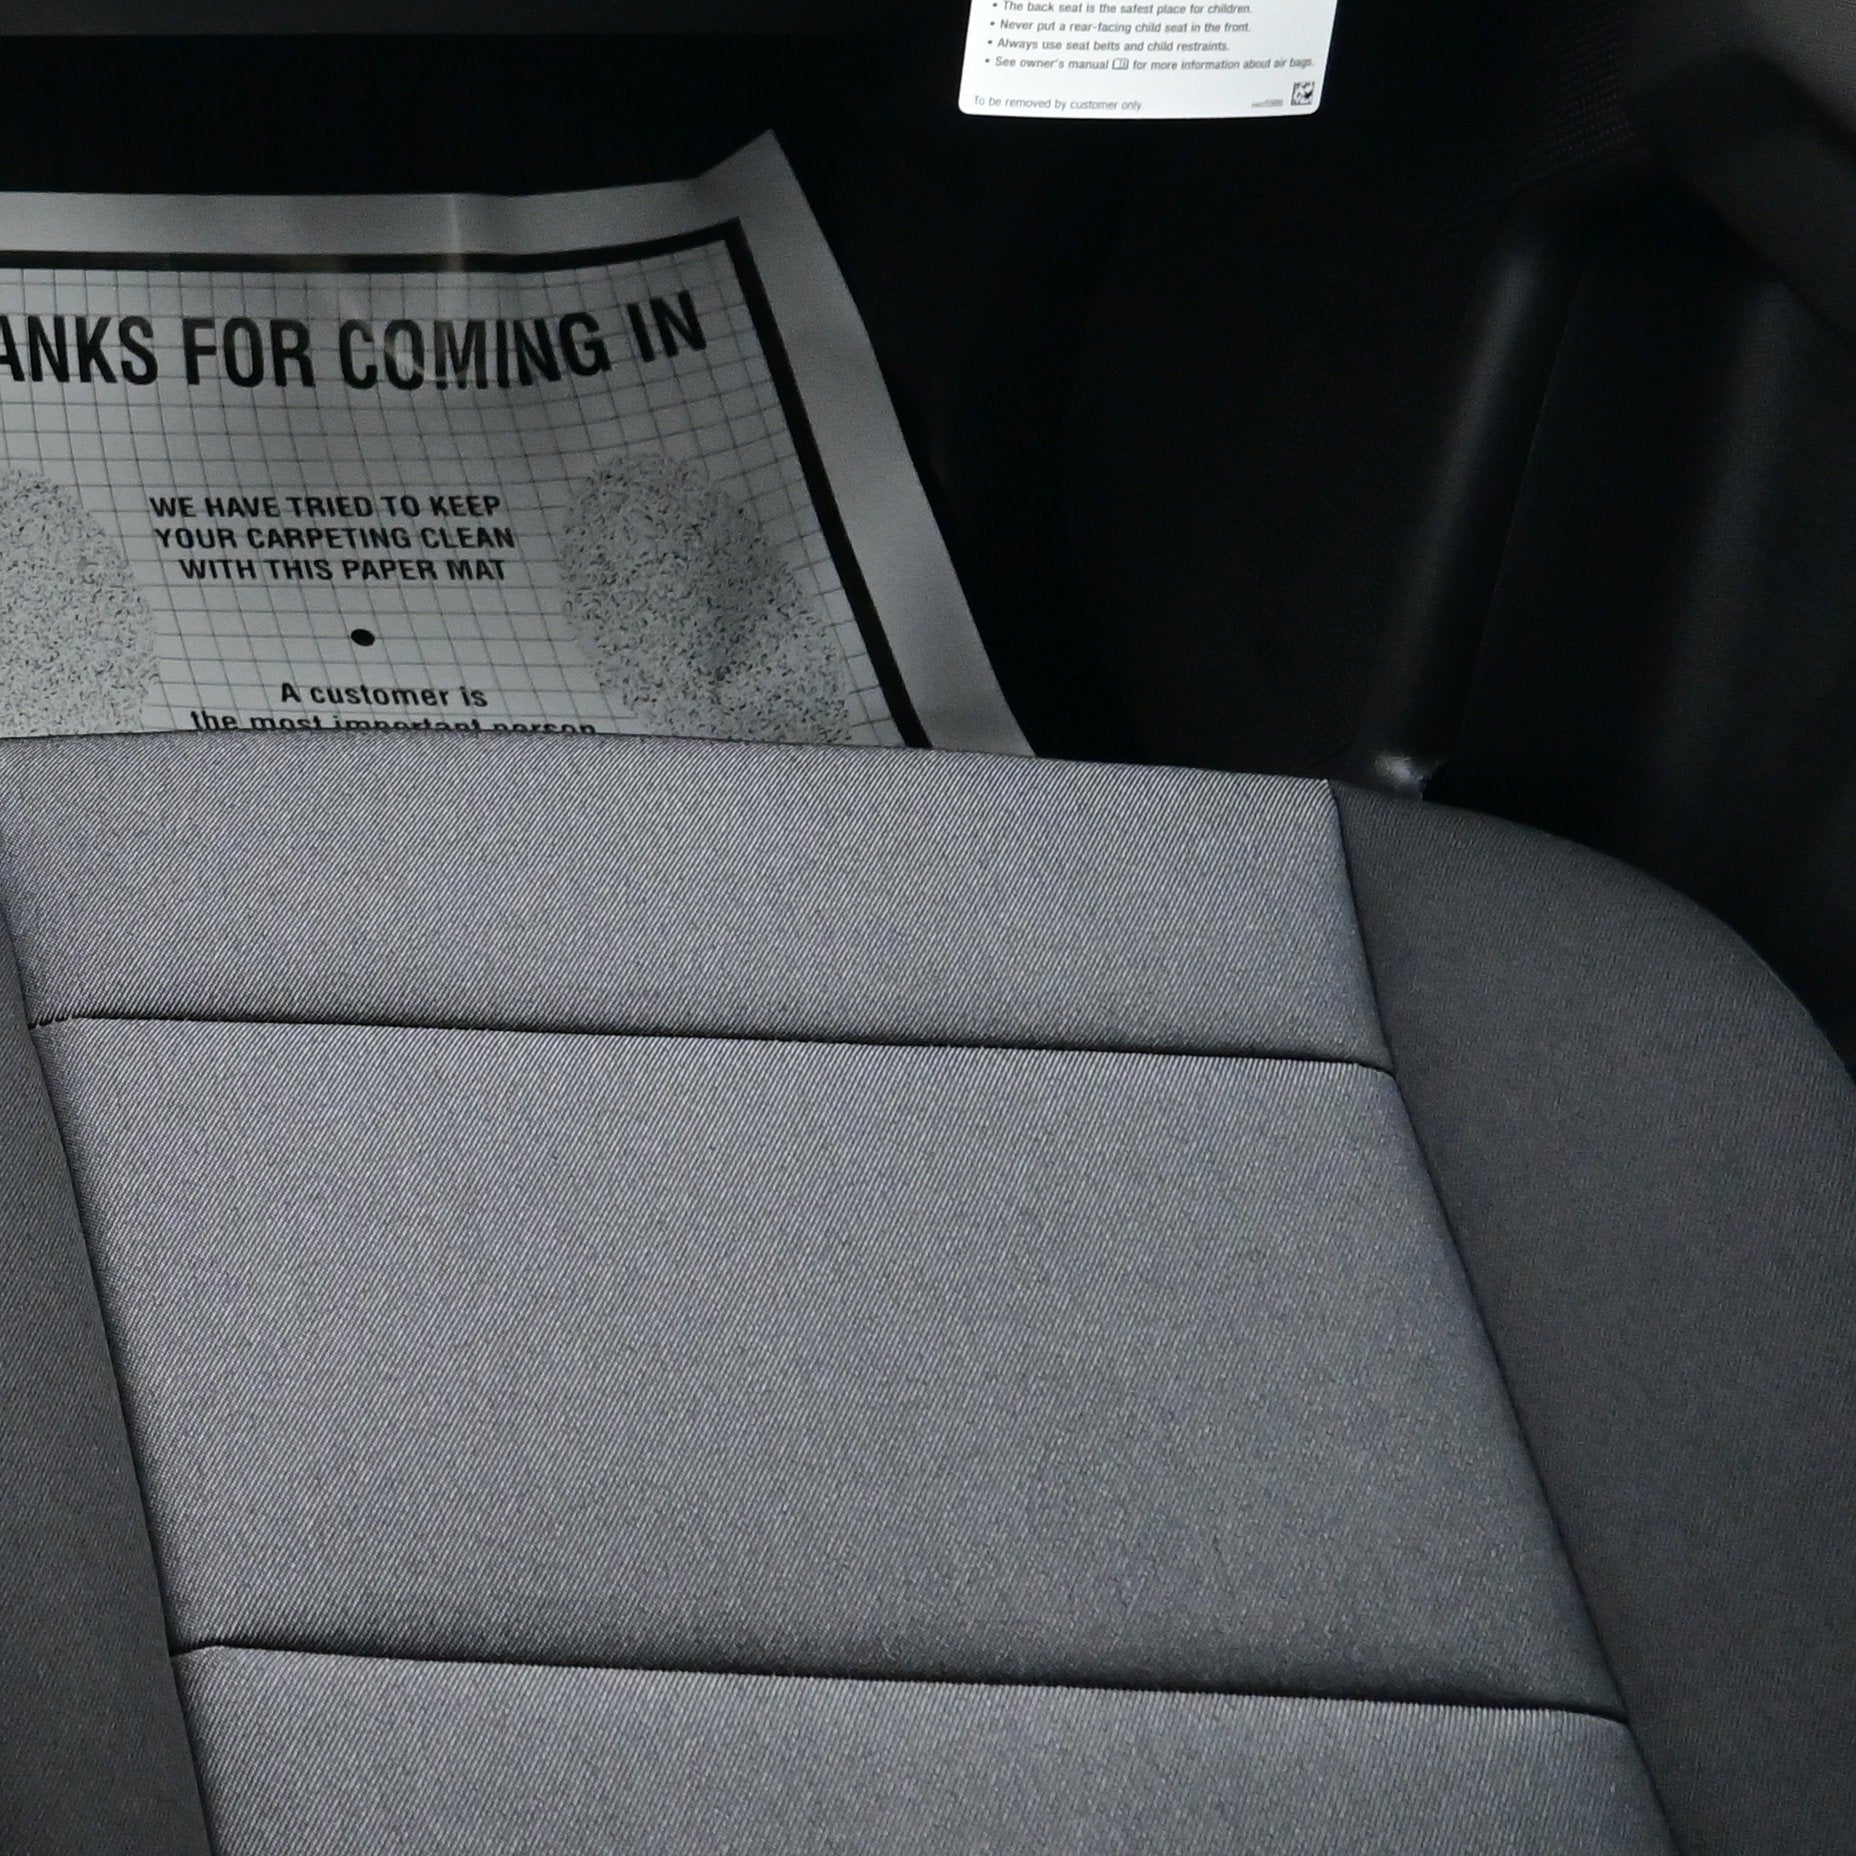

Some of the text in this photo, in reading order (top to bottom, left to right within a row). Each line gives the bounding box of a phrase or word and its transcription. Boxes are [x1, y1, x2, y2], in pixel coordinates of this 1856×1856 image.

[1002, 0, 1023, 11] The
[1026, 0, 1054, 12] back
[1058, 2, 1082, 13] seat
[1086, 2, 1096, 13] is
[1098, 2, 1117, 13] the
[1119, 2, 1153, 13] safest
[1155, 3, 1186, 16] place
[1189, 2, 1204, 14] for
[181, 316, 318, 388] FOR
[338, 310, 614, 393] COMING
[626, 290, 711, 365] IN
[148, 494, 502, 519] WE HAVE TRIED TO KEEP
[153, 525, 517, 550] YOUR CARPETING CLEAN
[177, 557, 508, 582] WITH THIS PAPER MAT
[279, 681, 489, 708] A customer is
